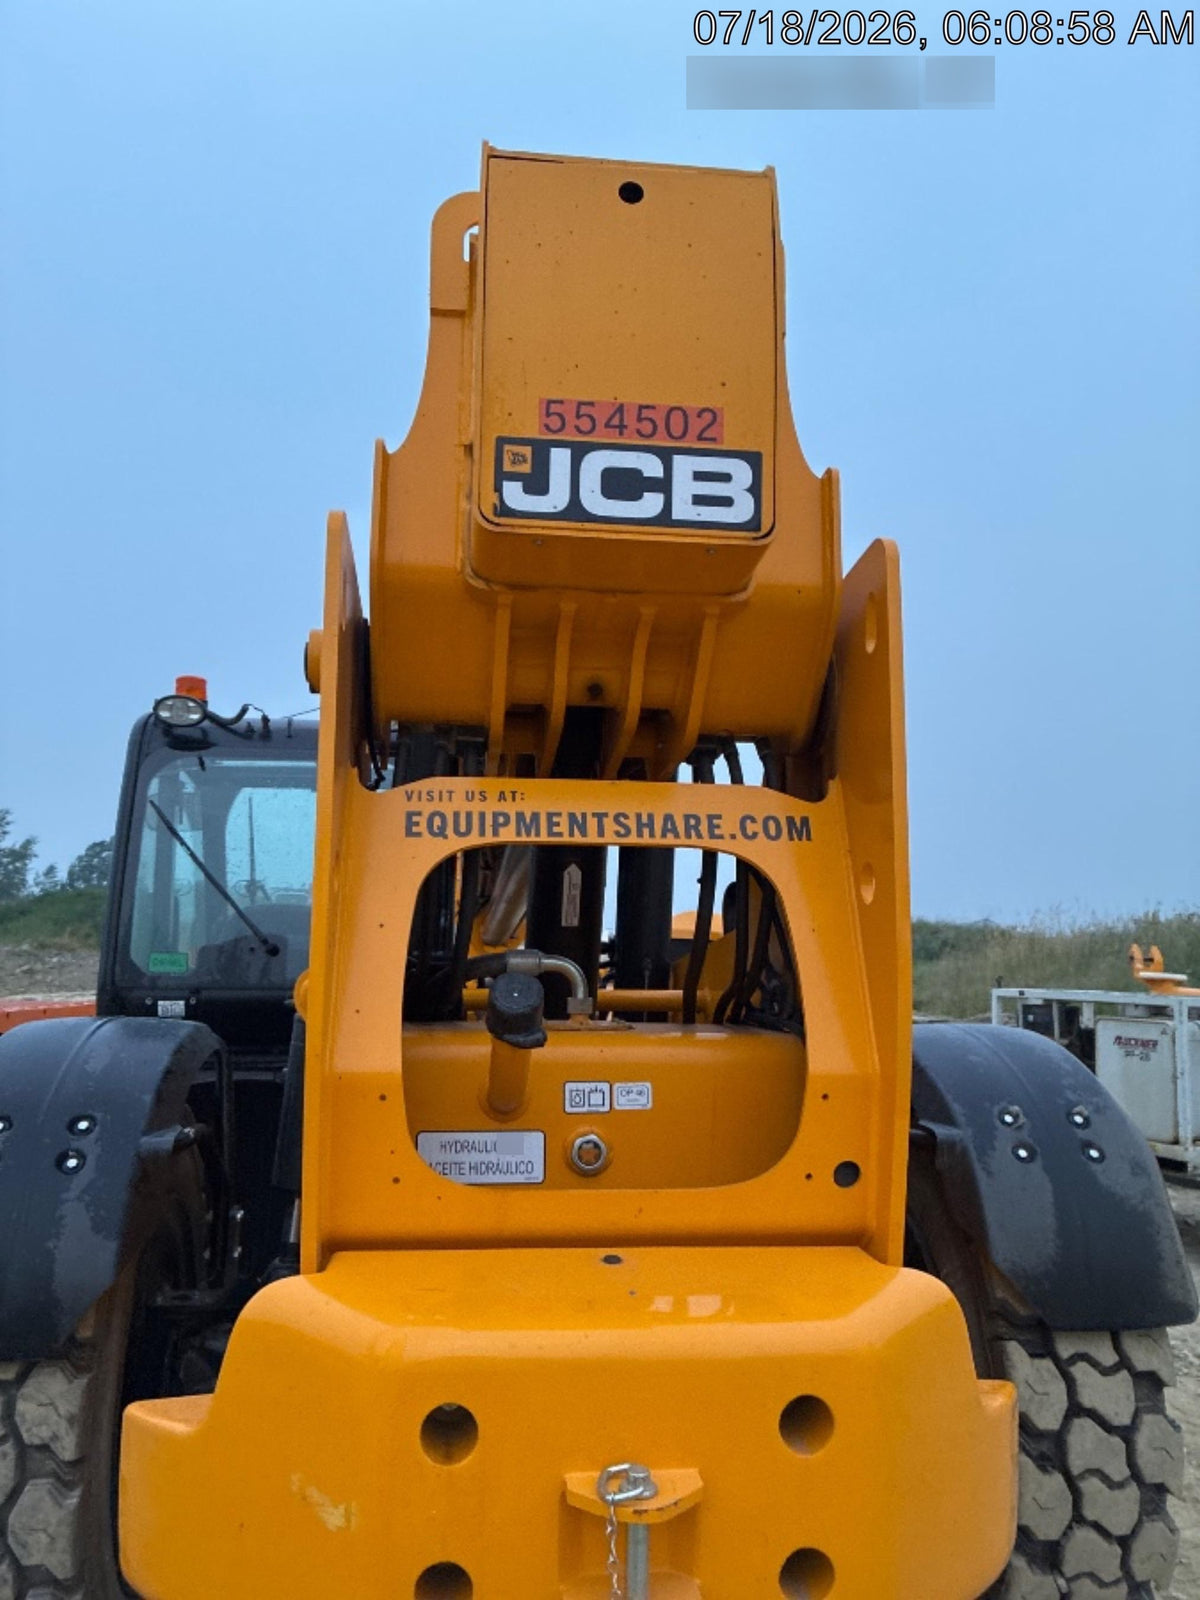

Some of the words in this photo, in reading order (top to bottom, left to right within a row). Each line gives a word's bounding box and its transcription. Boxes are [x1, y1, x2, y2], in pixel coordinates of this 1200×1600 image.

[543, 400, 718, 442] 554502
[502, 447, 755, 524] JCB
[404, 790, 456, 802] VISIT
[465, 790, 488, 803] US
[497, 790, 526, 803] AT:
[404, 810, 812, 842] EQUIPMENTSHARE.COM
